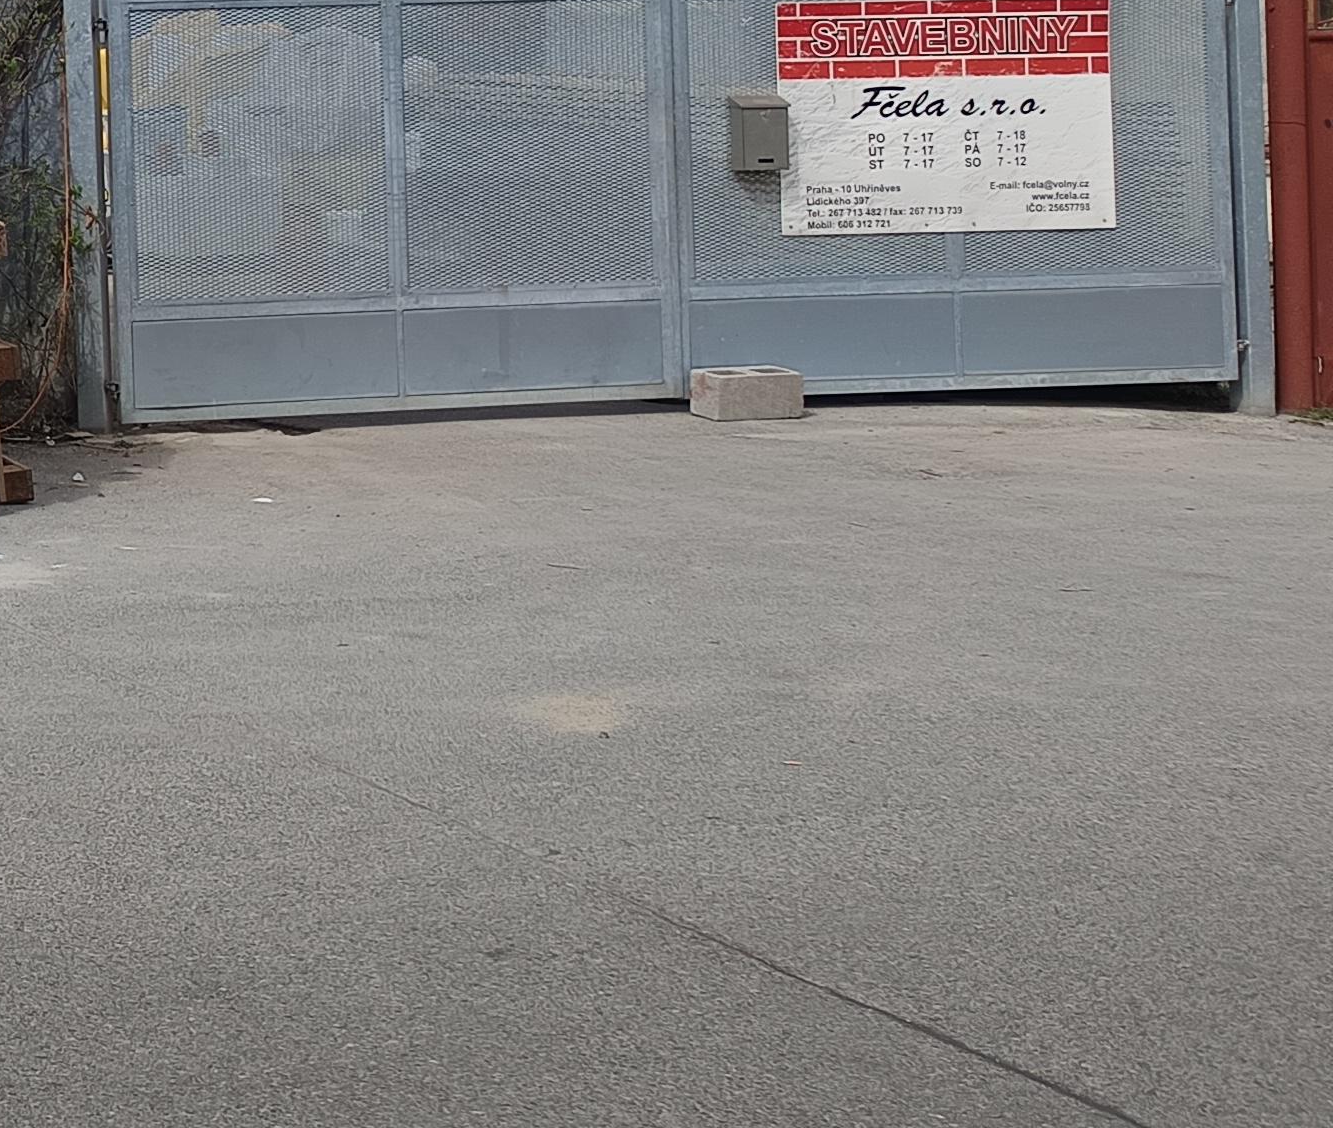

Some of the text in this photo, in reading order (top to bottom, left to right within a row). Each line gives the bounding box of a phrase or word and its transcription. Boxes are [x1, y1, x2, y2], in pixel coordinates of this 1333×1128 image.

[810, 15, 1079, 57] STAVEBNINY
[850, 86, 1047, 119] Fčela s.r.o.
[868, 133, 885, 143] PO
[902, 133, 908, 143] 7
[920, 133, 934, 142] 17
[964, 130, 979, 141] ČT
[996, 131, 1002, 140] 7
[1014, 130, 1026, 140] 18
[868, 145, 884, 157] ÚT
[903, 146, 909, 156] 7
[921, 146, 934, 156] 17
[965, 143, 981, 154] PÁ
[997, 144, 1003, 153] 7
[1014, 144, 1026, 153] 17
[868, 159, 884, 170] ST
[904, 159, 910, 169] 7
[922, 159, 934, 168] 17
[965, 158, 982, 167] SO
[998, 157, 1003, 166] 7
[1015, 157, 1027, 166] 12
[806, 185, 833, 194] Praha
[841, 185, 852, 193] 10
[989, 179, 1090, 192] E-mail: fcela@volny.cz
[806, 196, 869, 206] Lidického 397
[1031, 192, 1090, 202] www.fcela.cz
[828, 208, 844, 217] 267
[846, 208, 863, 217] 713
[889, 207, 907, 216] fax:
[909, 206, 925, 216] 267
[928, 206, 944, 215] 713
[947, 206, 963, 215] 739
[1026, 203, 1046, 212] IČO:
[807, 220, 835, 230] Mobil:
[856, 219, 873, 228] 312
[875, 219, 891, 228] 721
